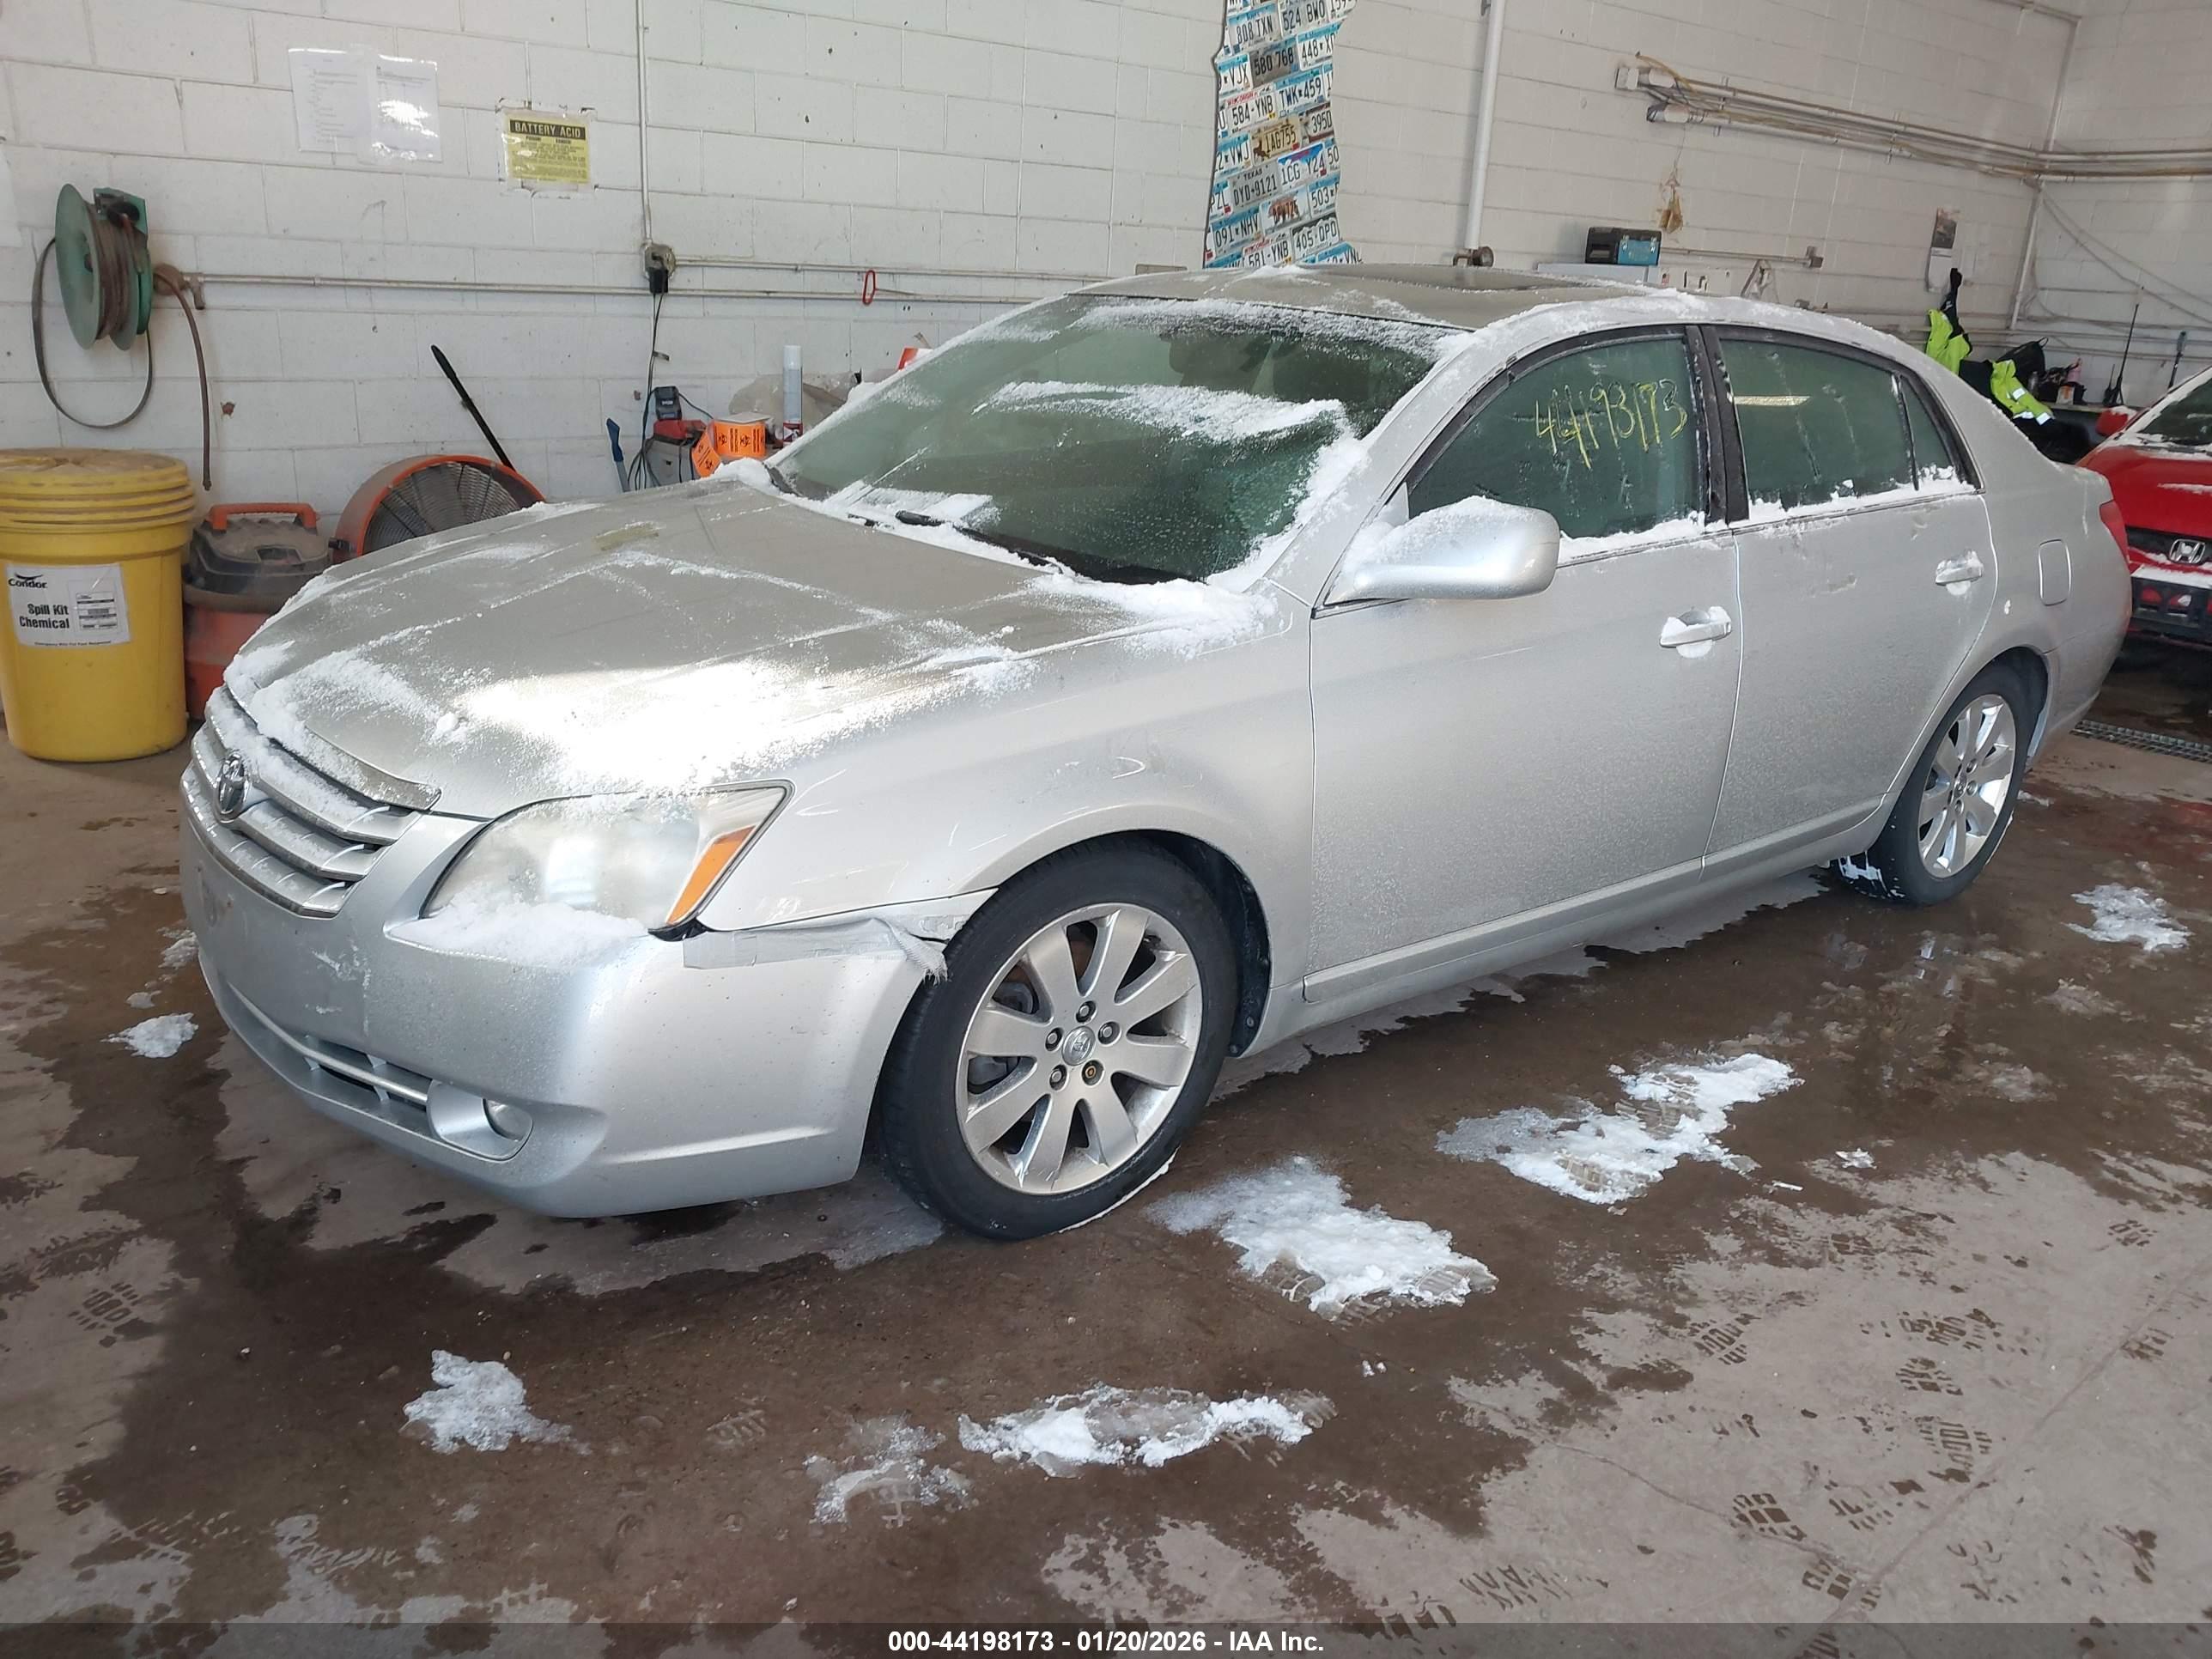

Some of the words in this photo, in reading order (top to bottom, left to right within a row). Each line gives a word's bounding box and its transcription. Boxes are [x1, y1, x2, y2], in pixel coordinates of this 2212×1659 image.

[514, 121, 556, 136] BATTERY
[560, 125, 580, 138] ACID
[8, 577, 47, 589] Condor
[27, 603, 51, 616] Spill
[53, 604, 70, 615] Kit
[19, 616, 70, 629] Chemical
